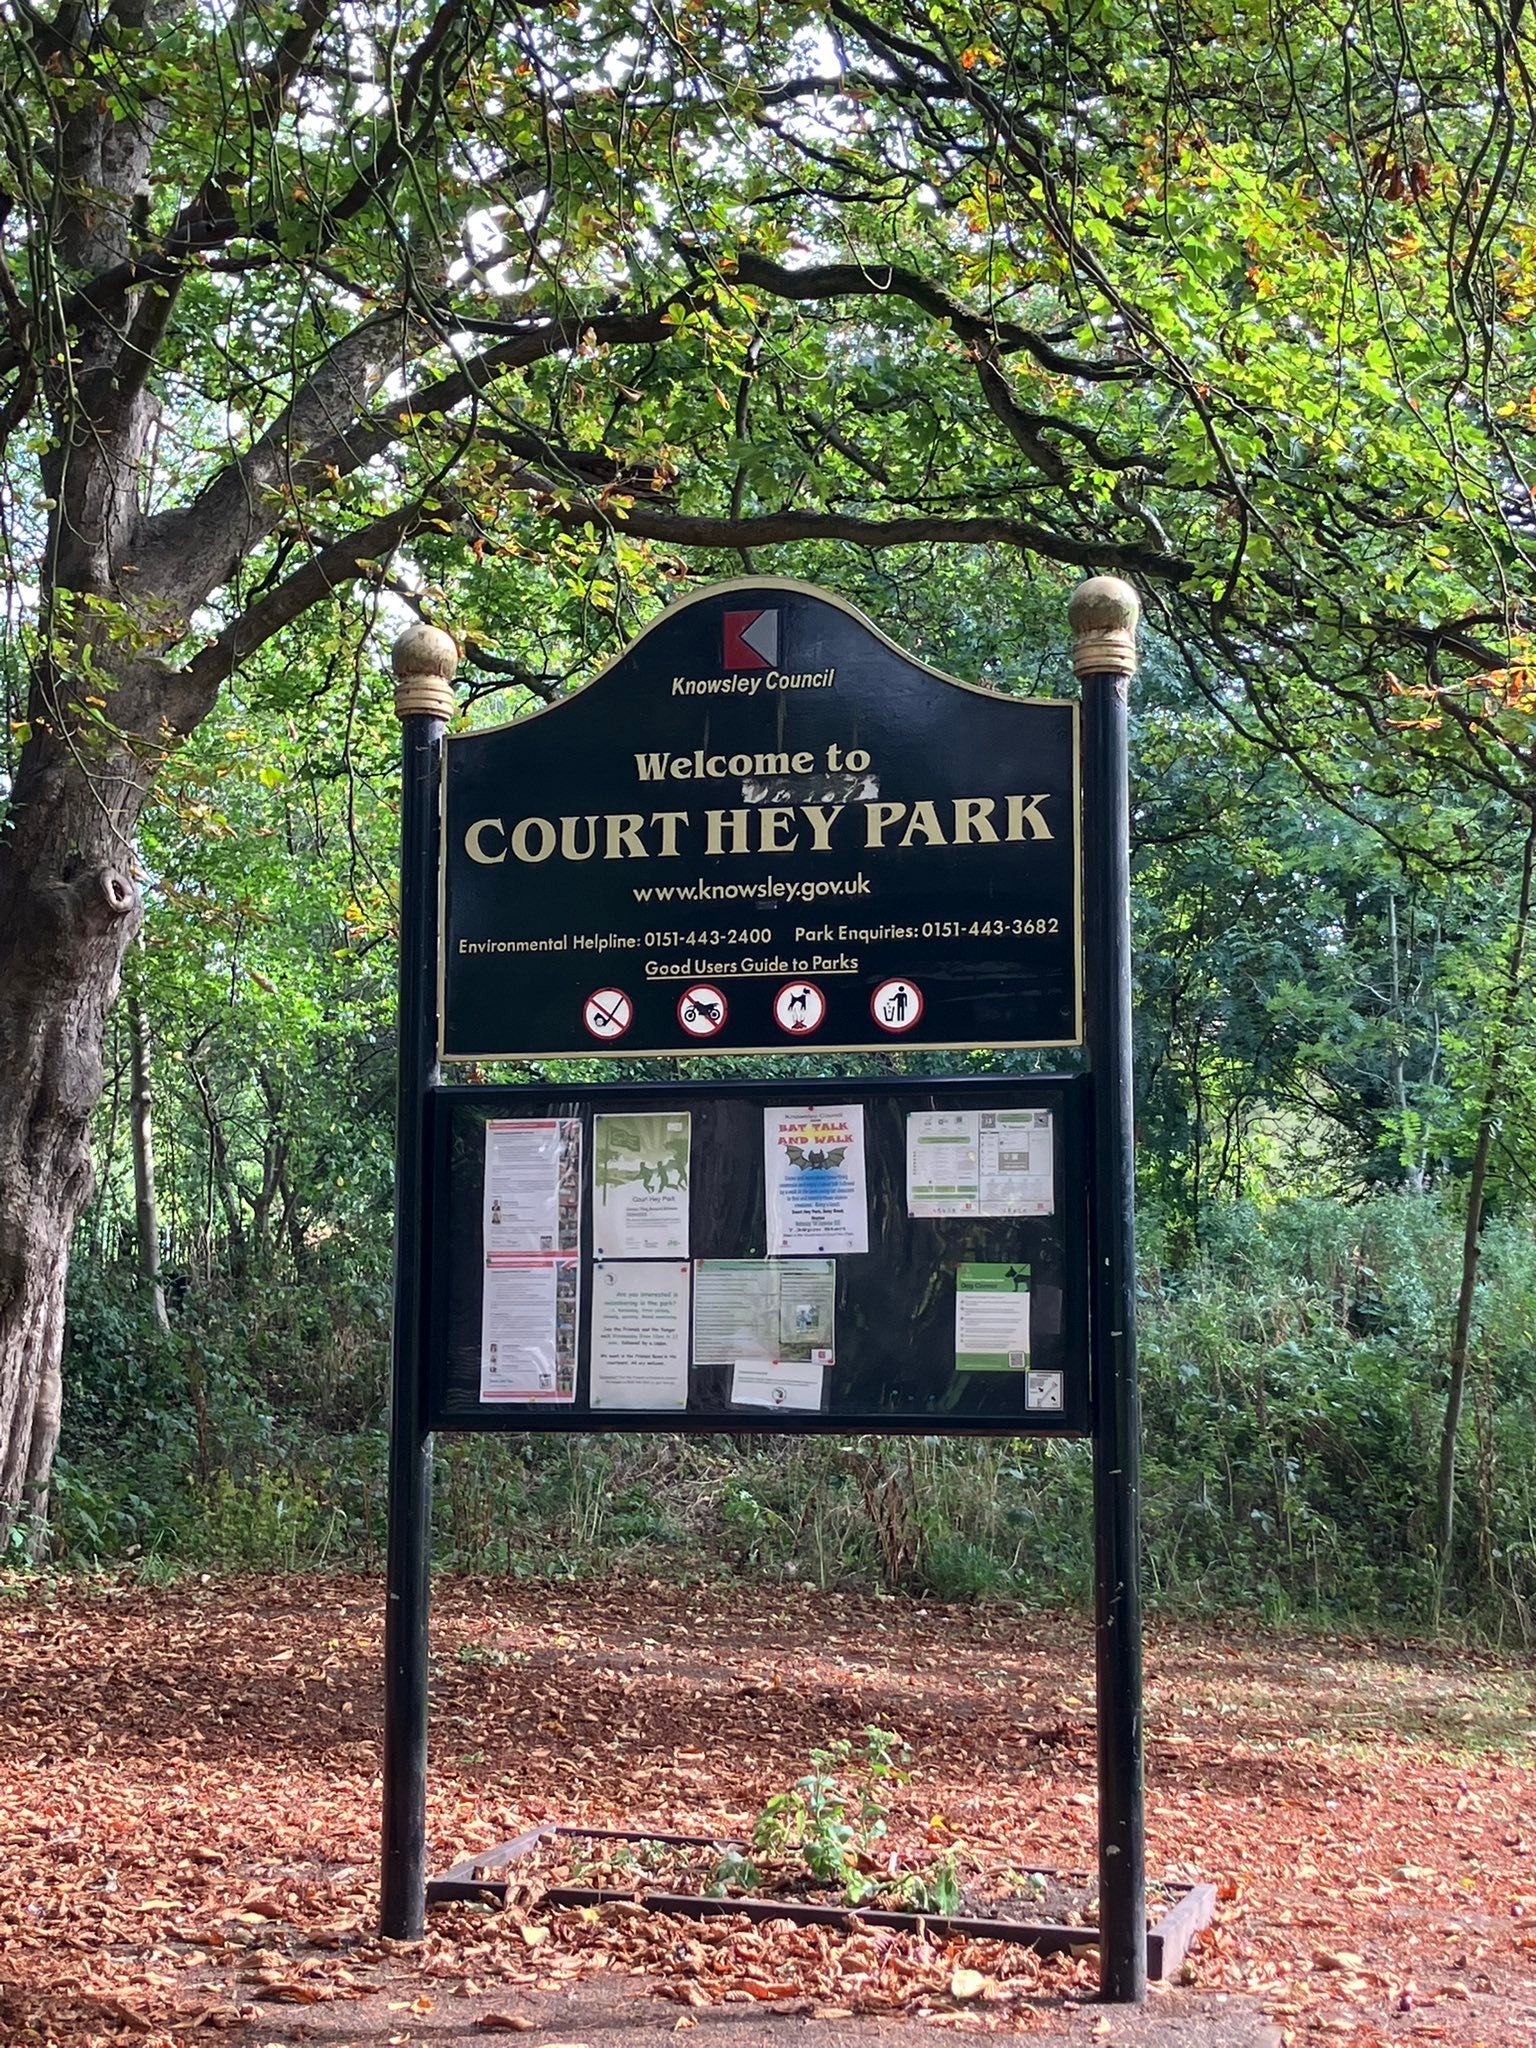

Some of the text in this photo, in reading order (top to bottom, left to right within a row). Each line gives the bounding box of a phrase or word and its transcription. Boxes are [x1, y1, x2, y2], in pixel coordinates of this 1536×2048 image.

[672, 668, 835, 696] Knowsley Council
[635, 743, 871, 781] Welcome to
[464, 793, 1055, 865] COURT HEY PARK
[633, 872, 872, 903] www.knowsley.gov.uk
[459, 928, 772, 955] Environmental Helpline: 0151-443-2400
[795, 918, 1059, 944] Park Enquiries: 0151-443-3682
[645, 953, 859, 976] Good Users Guide to Parks
[778, 1134, 854, 1145] AND WALK
[779, 1122, 848, 1132] BAT TALK
